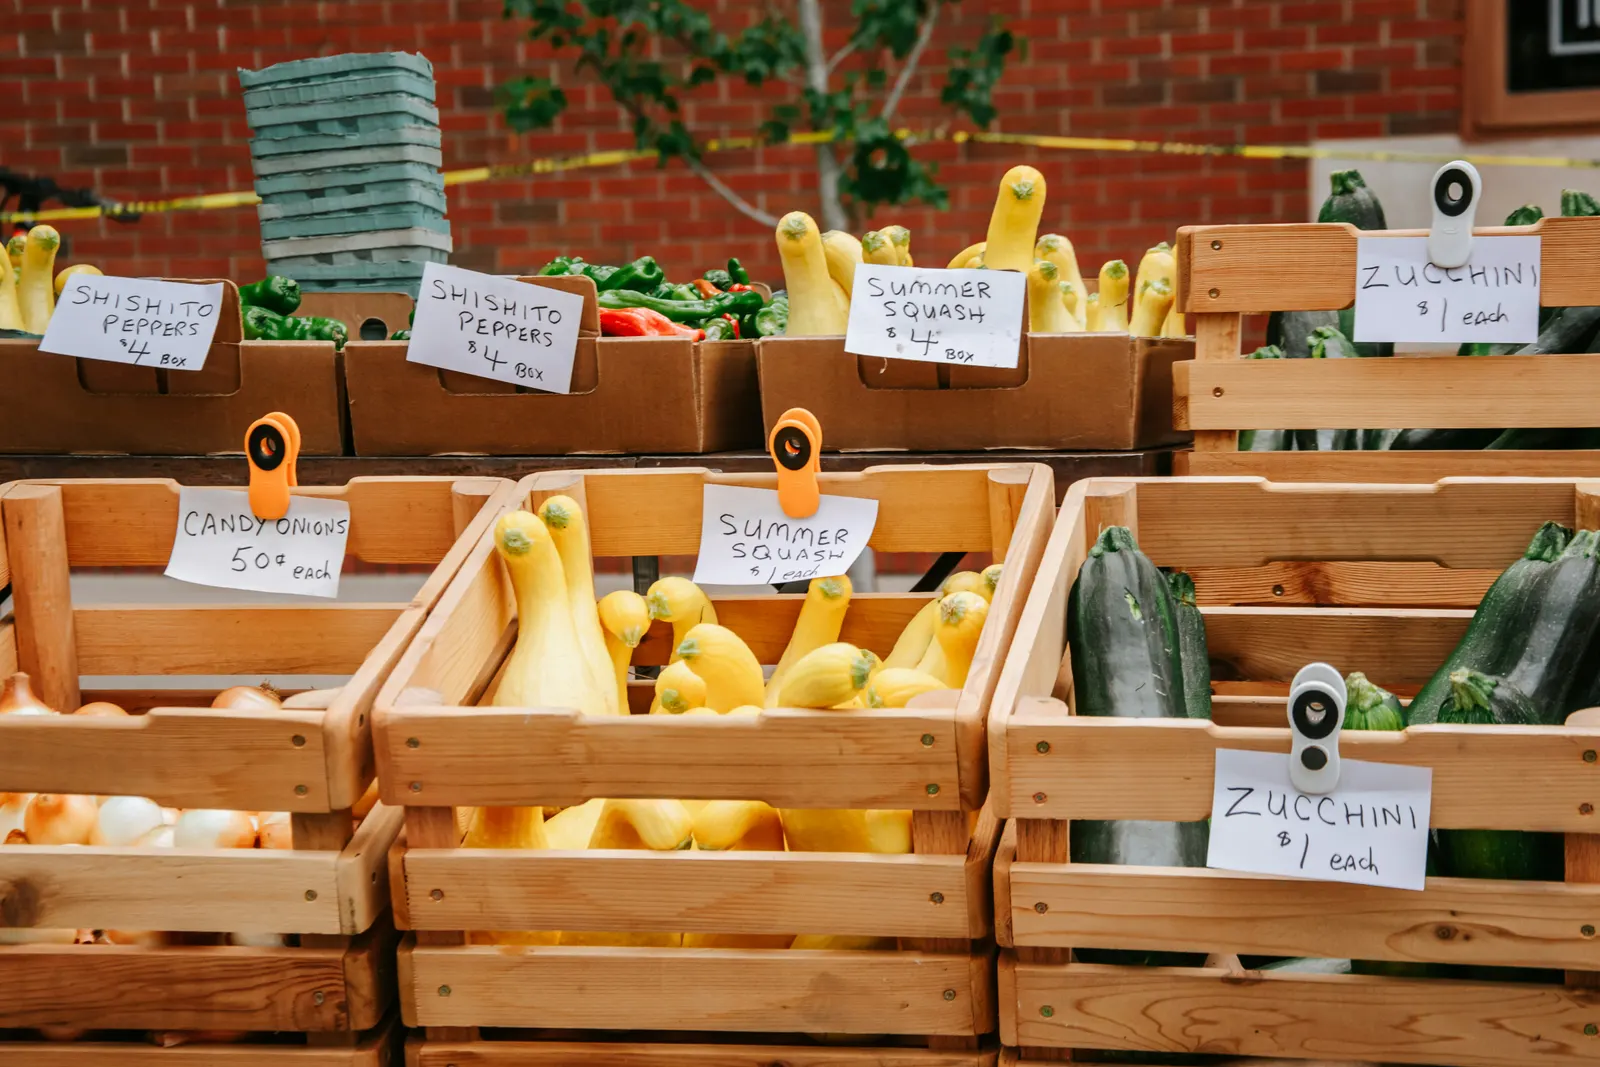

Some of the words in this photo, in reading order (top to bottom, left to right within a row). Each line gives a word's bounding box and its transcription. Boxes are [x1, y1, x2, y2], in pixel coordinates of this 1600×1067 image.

[867, 277, 992, 299] SUMMER
[1362, 261, 1538, 290] ZUCCHINI
[72, 285, 214, 318] SHISHITO
[431, 279, 562, 325] SHISHITO
[883, 300, 985, 324] SQUASH
[1416, 297, 1448, 333] $1
[102, 314, 200, 337] PEPPERS
[459, 310, 553, 347] PEPPERS
[184, 510, 266, 536] CANDY
[275, 517, 348, 537] ONIONS
[719, 513, 849, 547] SUMMER
[731, 542, 845, 562] SQUASH
[1224, 787, 1417, 829] ZUCCHINI
[1276, 830, 1309, 869] $1
